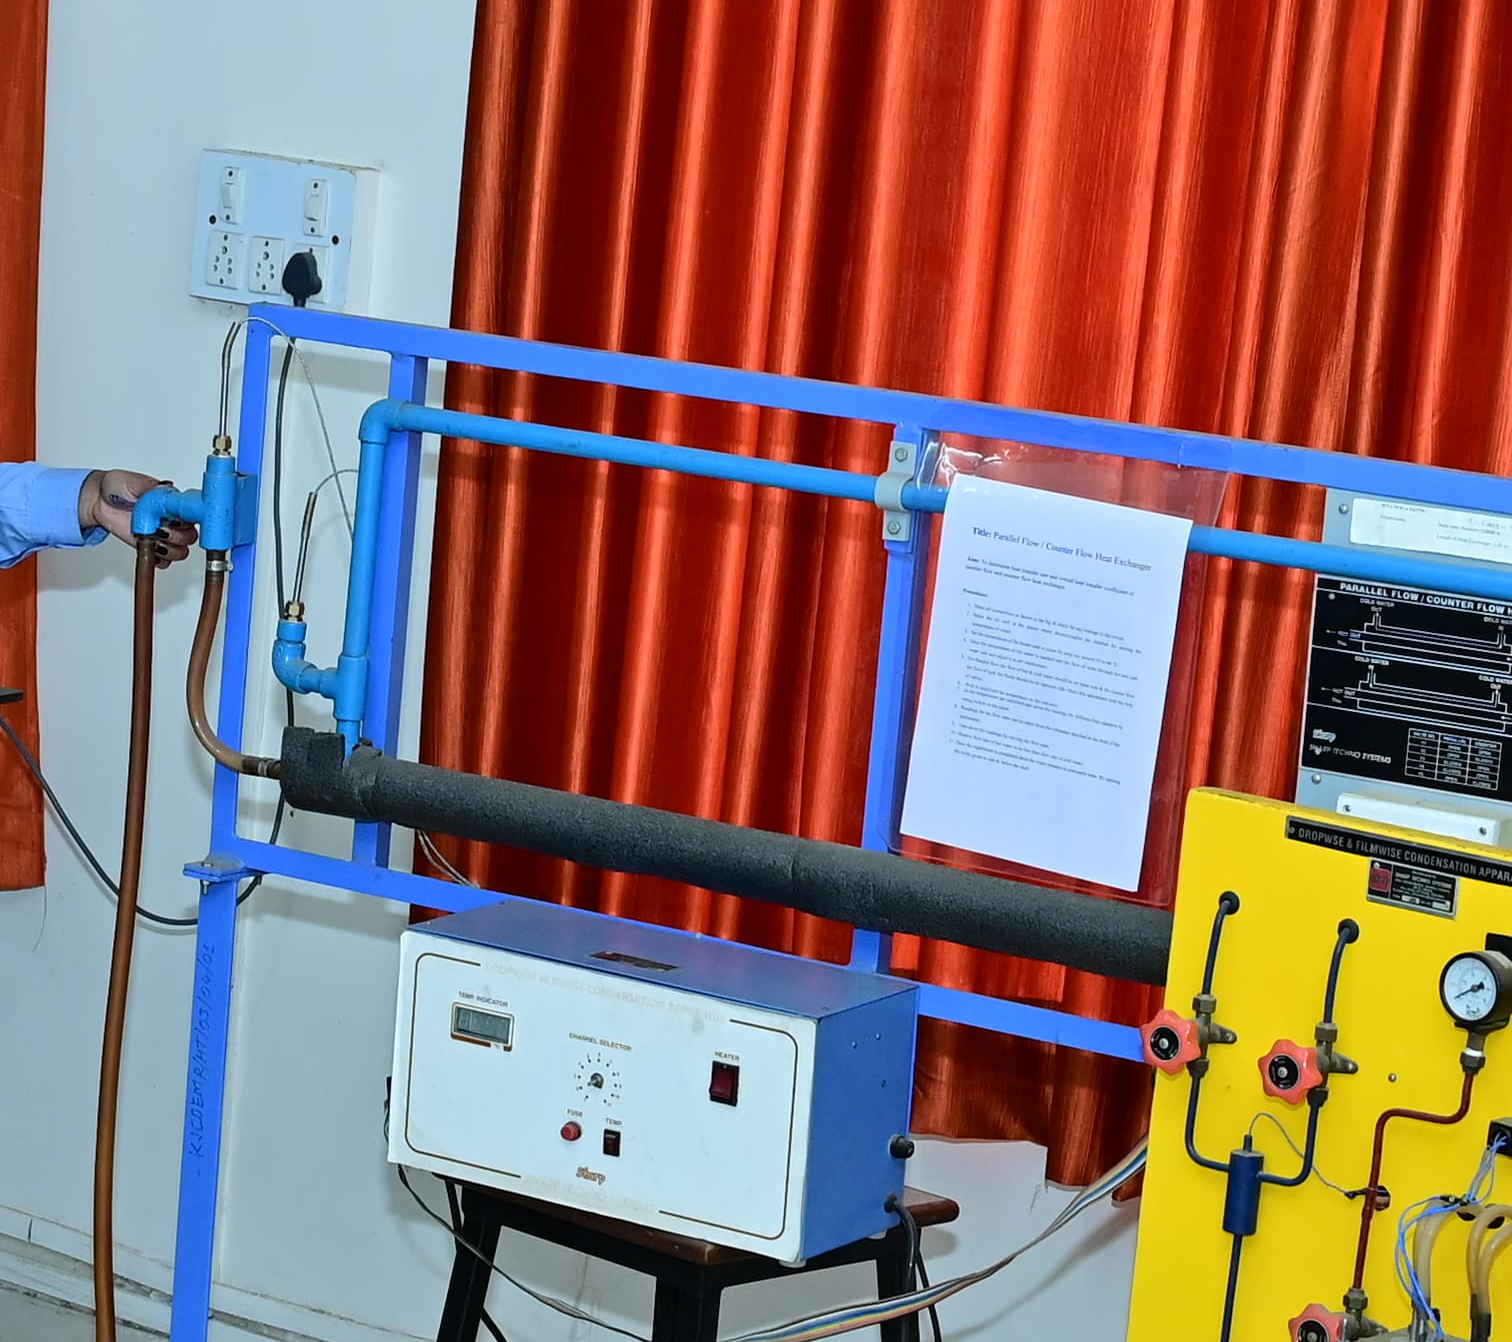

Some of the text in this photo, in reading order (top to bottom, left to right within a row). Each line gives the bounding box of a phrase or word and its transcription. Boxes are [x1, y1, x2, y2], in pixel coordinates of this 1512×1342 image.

[972, 526, 992, 538] Title:
[993, 531, 1020, 544] Parallel
[1021, 537, 1040, 548] Flow
[1045, 543, 1074, 556] Counter
[1075, 548, 1093, 559] Flow
[1095, 552, 1112, 563] Heat
[1114, 556, 1152, 572] Exchanger
[1340, 582, 1389, 597] PARALLEL
[1391, 590, 1419, 602] FLOW
[1420, 593, 1425, 603] /
[1426, 595, 1474, 610] COUNTER
[1477, 600, 1505, 613] FLOW
[1298, 827, 1344, 847] DROPWSE
[1346, 837, 1353, 849] &
[1356, 840, 1402, 860] FILMWISE
[1404, 850, 1477, 876] CONDENSATION
[476, 995, 508, 1007] INDICATOR
[569, 1032, 632, 1052] CHANNEL SELECTOR
[714, 1051, 740, 1062] HEATER
[567, 1108, 583, 1118] FUSE
